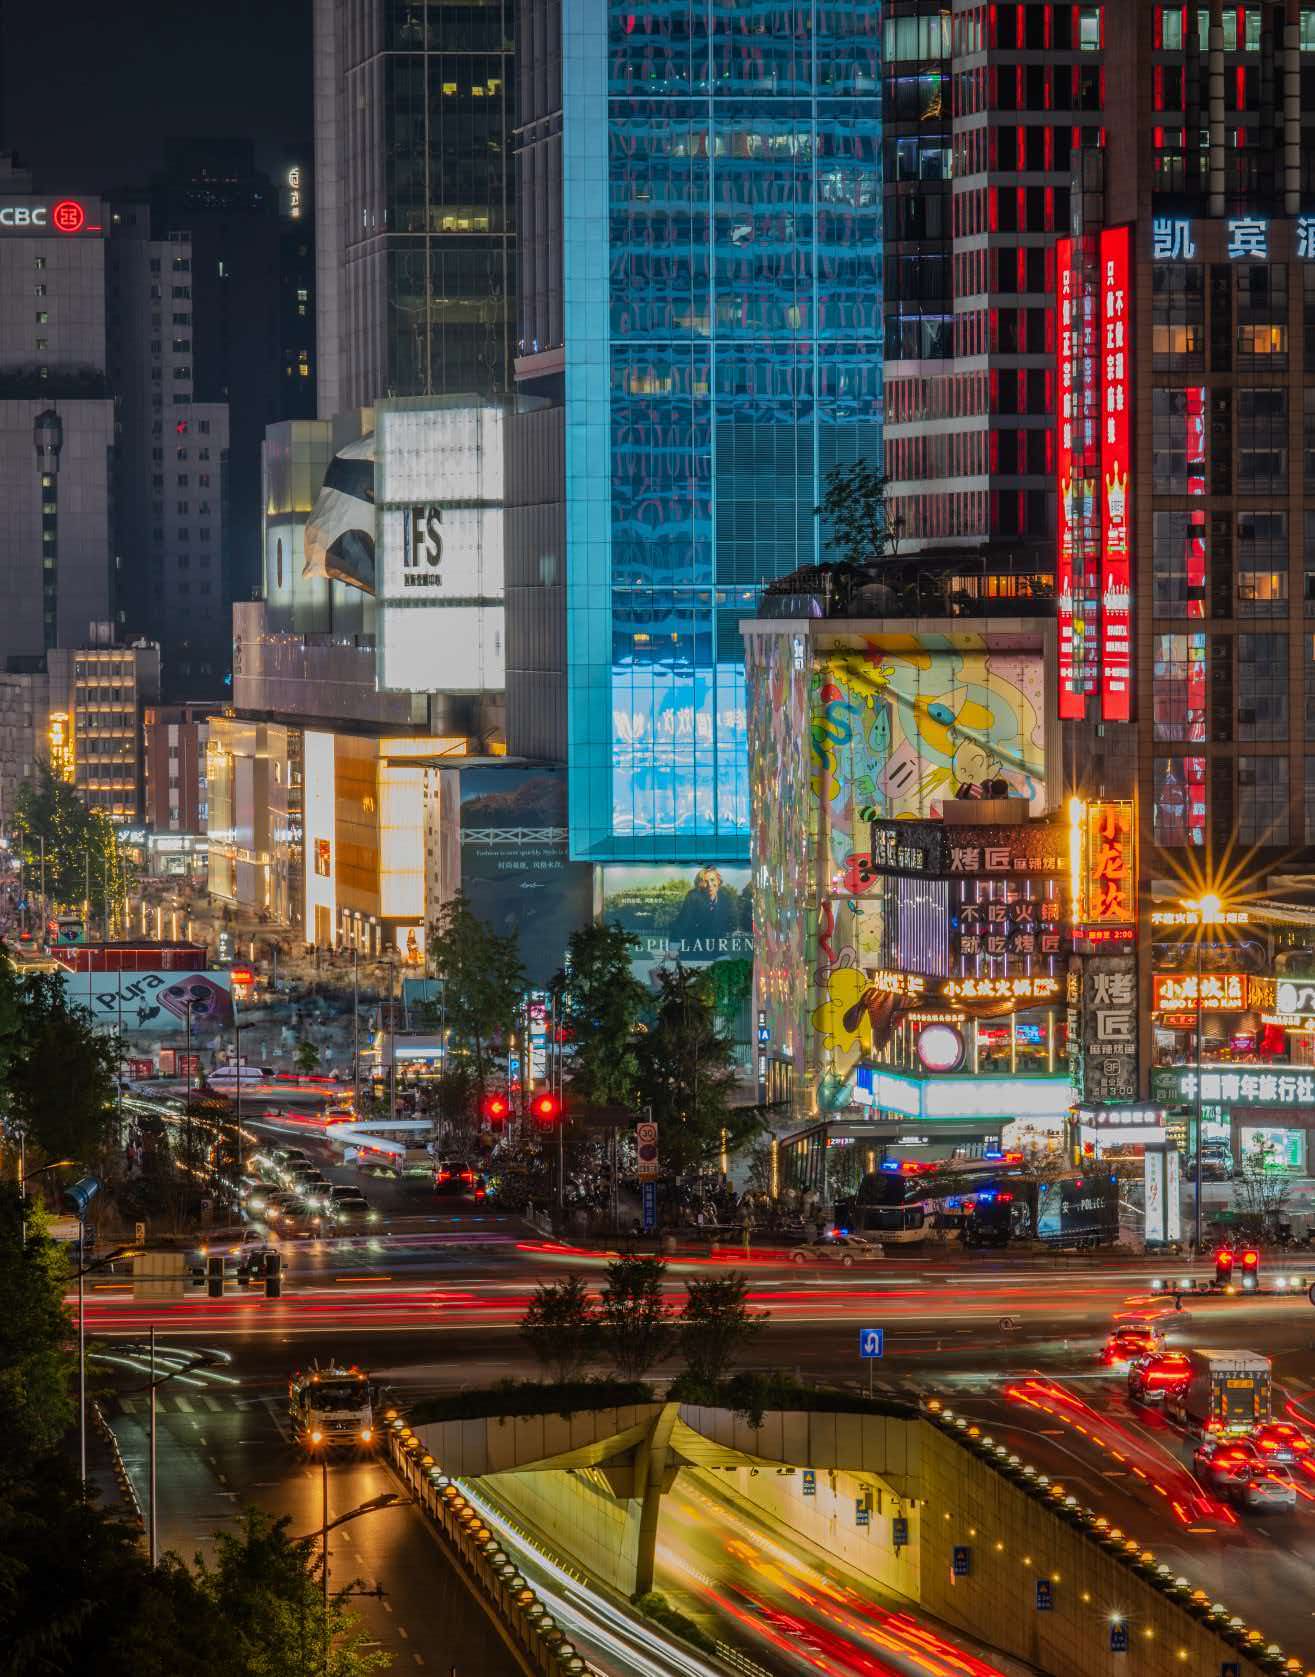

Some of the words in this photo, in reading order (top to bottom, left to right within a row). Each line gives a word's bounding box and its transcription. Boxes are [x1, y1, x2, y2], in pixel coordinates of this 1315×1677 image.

[950, 847, 1011, 871] 烤匠
[961, 903, 1060, 922] 不吃火锅
[960, 934, 1061, 954] 就吃烤匠
[96, 974, 165, 1010] Pura
[1093, 973, 1134, 1039] 烤匠
[1105, 1062, 1119, 1073] 3F
[1181, 1073, 1315, 1101] 中国青年旅行社
